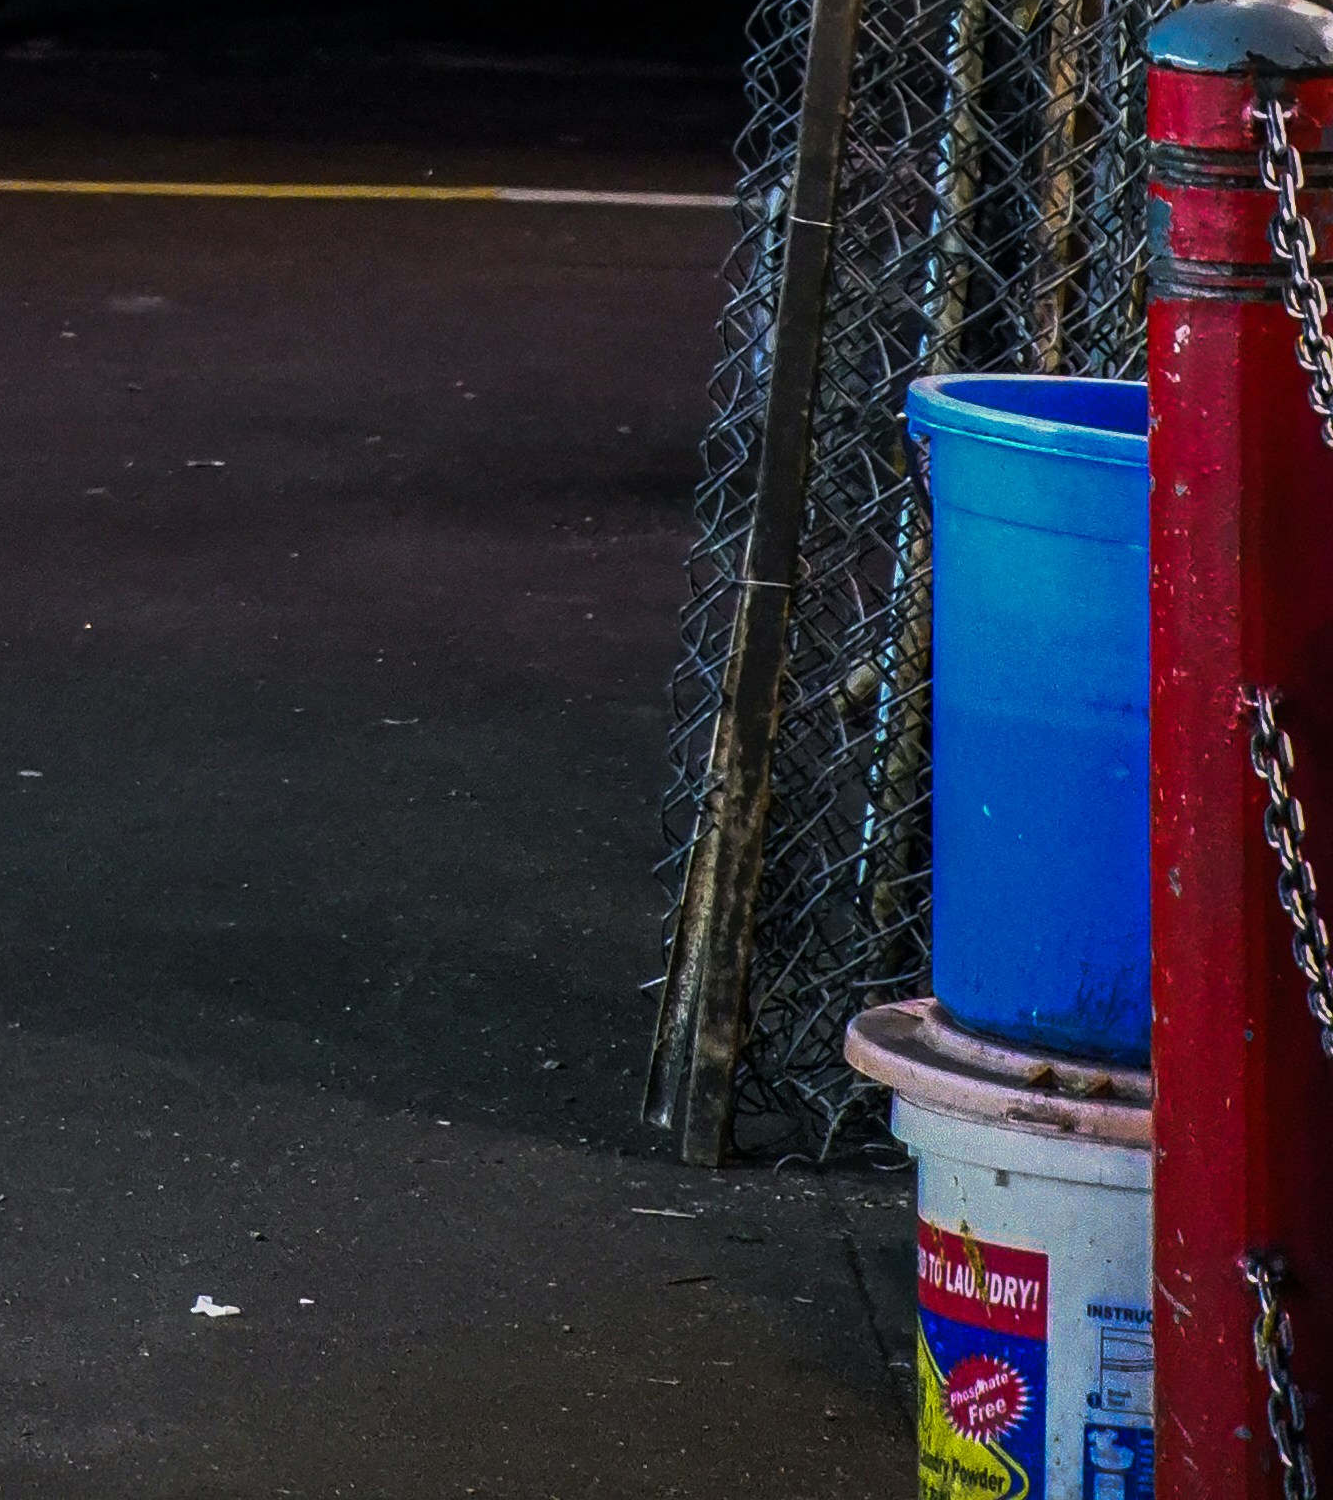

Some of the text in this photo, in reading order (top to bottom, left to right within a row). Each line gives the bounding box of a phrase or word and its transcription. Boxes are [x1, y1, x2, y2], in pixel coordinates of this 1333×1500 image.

[928, 1253, 943, 1287] TO
[950, 1372, 1010, 1407] Phosphate
[967, 1397, 1007, 1426] Free
[951, 1457, 1006, 1493] Powder
